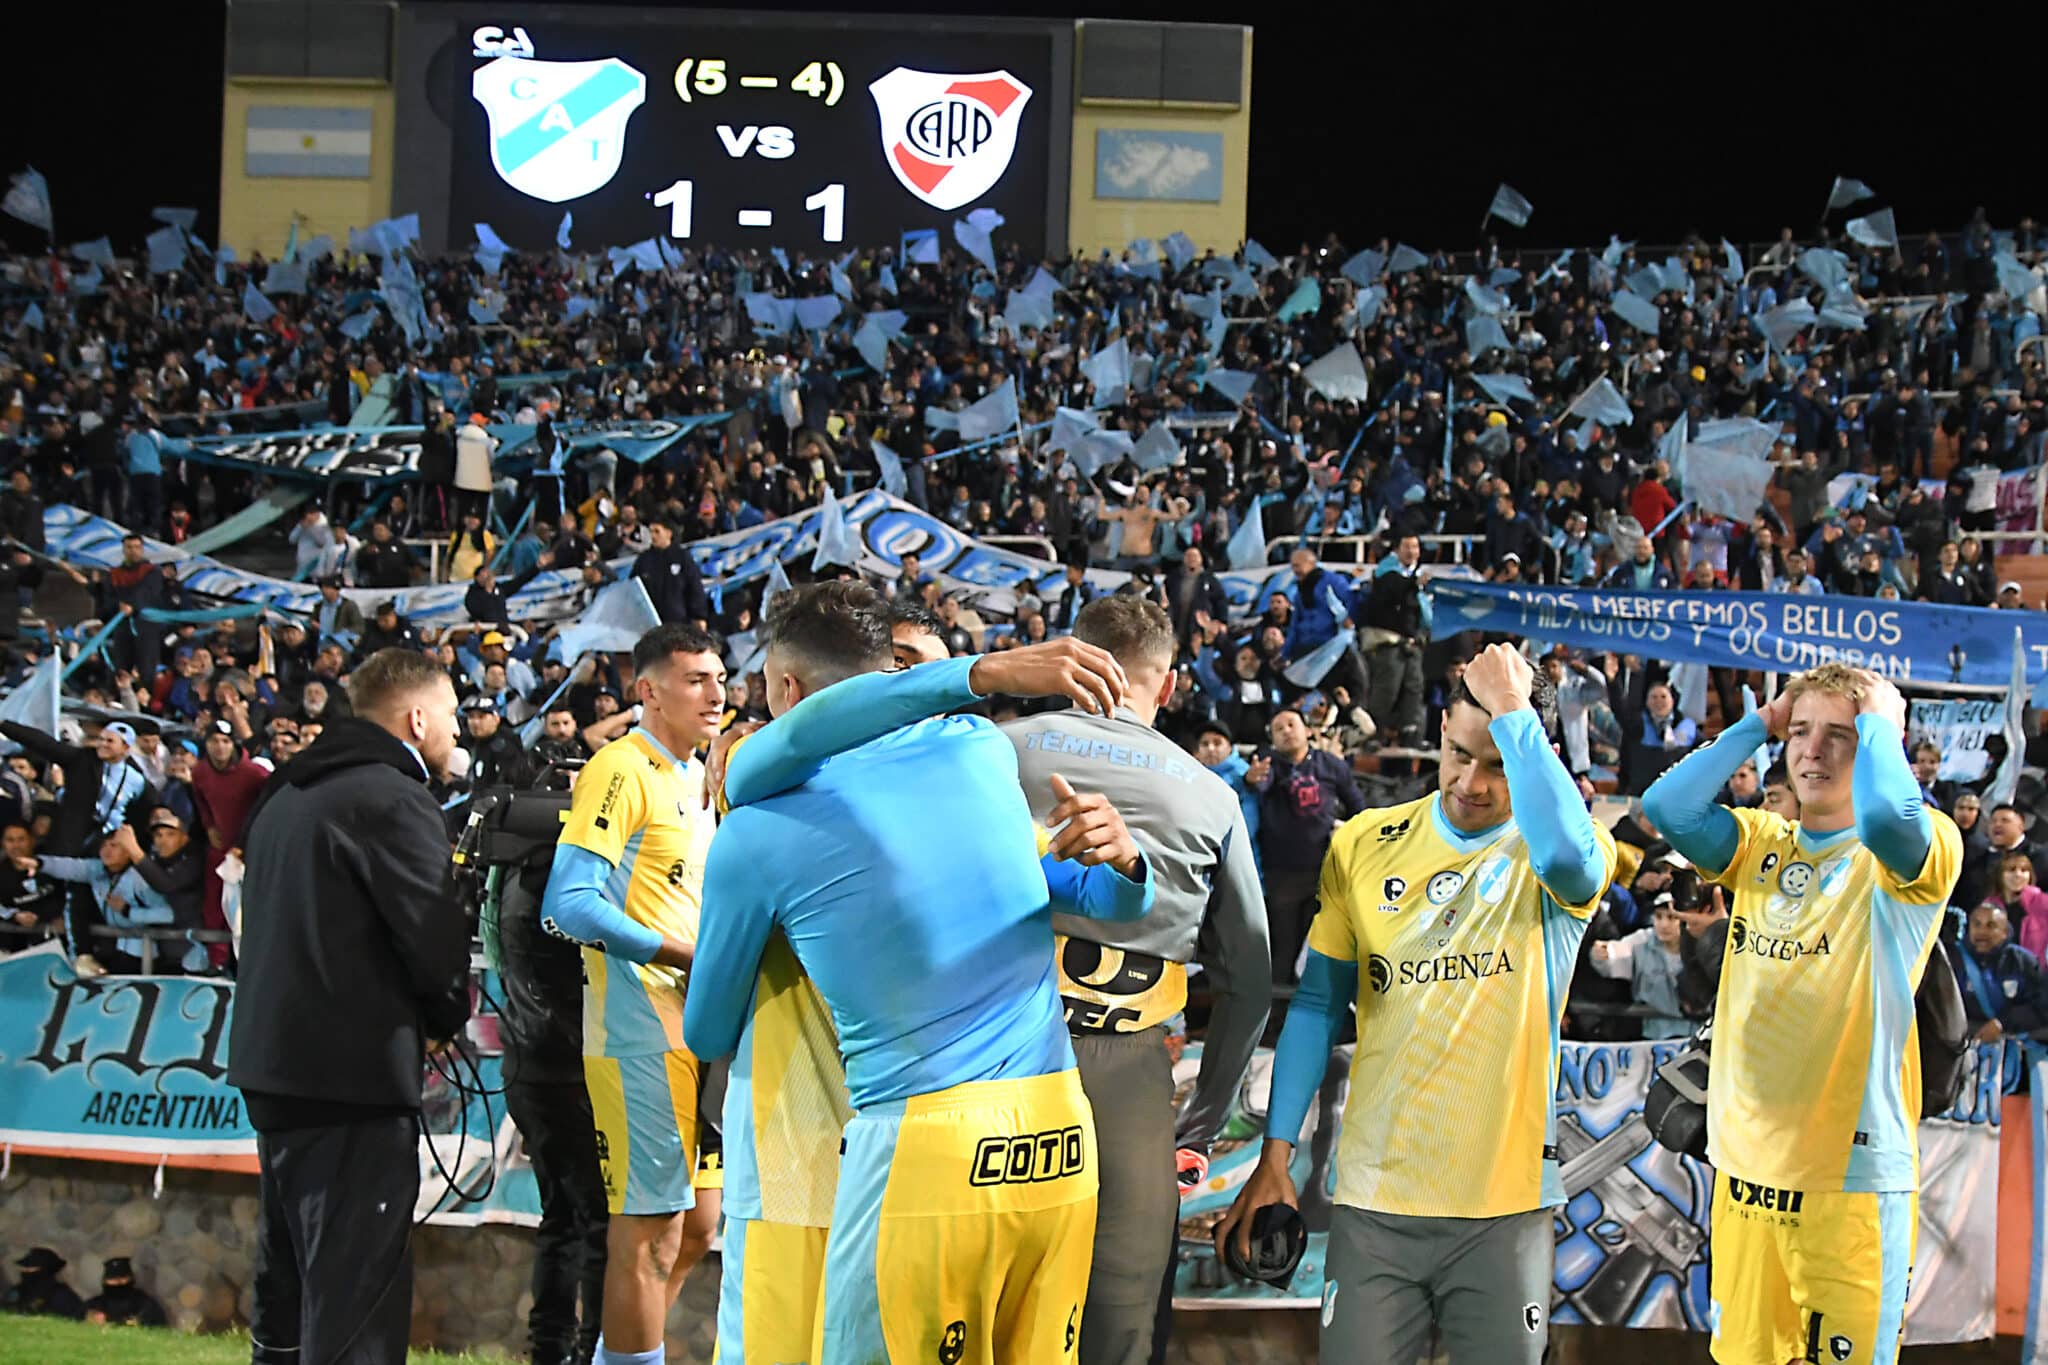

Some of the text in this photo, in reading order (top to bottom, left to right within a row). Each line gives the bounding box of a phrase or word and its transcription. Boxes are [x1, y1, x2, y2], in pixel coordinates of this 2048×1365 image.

[905, 101, 992, 158] CARP
[654, 180, 693, 238] 1
[806, 184, 845, 242] 1
[1783, 603, 1902, 646] BELLOS
[1026, 729, 1198, 784] TEMPERLEY
[1378, 904, 1400, 912] LYON
[1400, 948, 1514, 985] SCIENZA
[82, 1091, 239, 1130] ARGENTINA
[969, 1125, 1085, 1187] COTO
